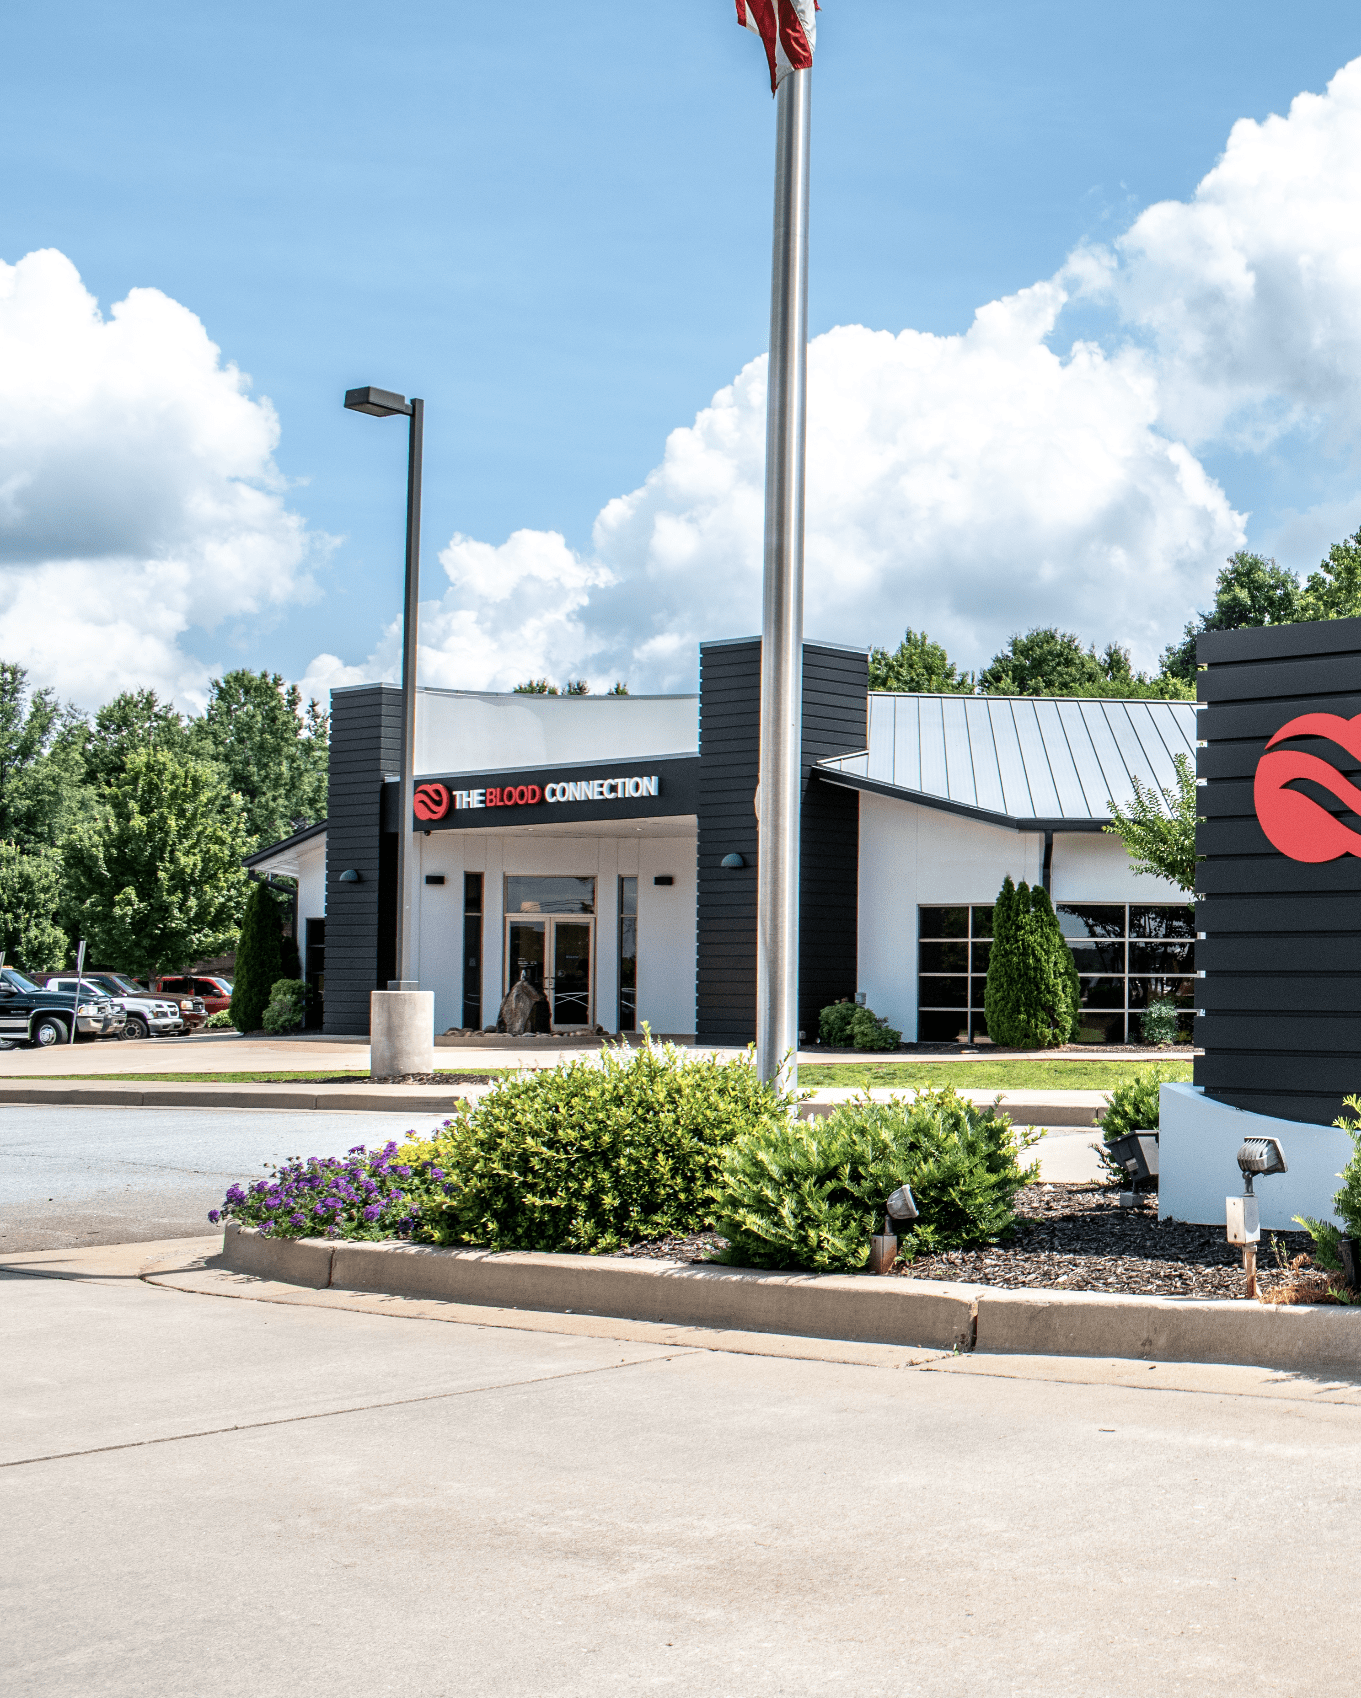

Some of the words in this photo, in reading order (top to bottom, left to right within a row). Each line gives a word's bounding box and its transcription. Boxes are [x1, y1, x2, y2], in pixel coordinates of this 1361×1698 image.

[452, 789, 486, 810] THE
[485, 784, 543, 808] BLOOD
[544, 775, 659, 803] CONNECTION
